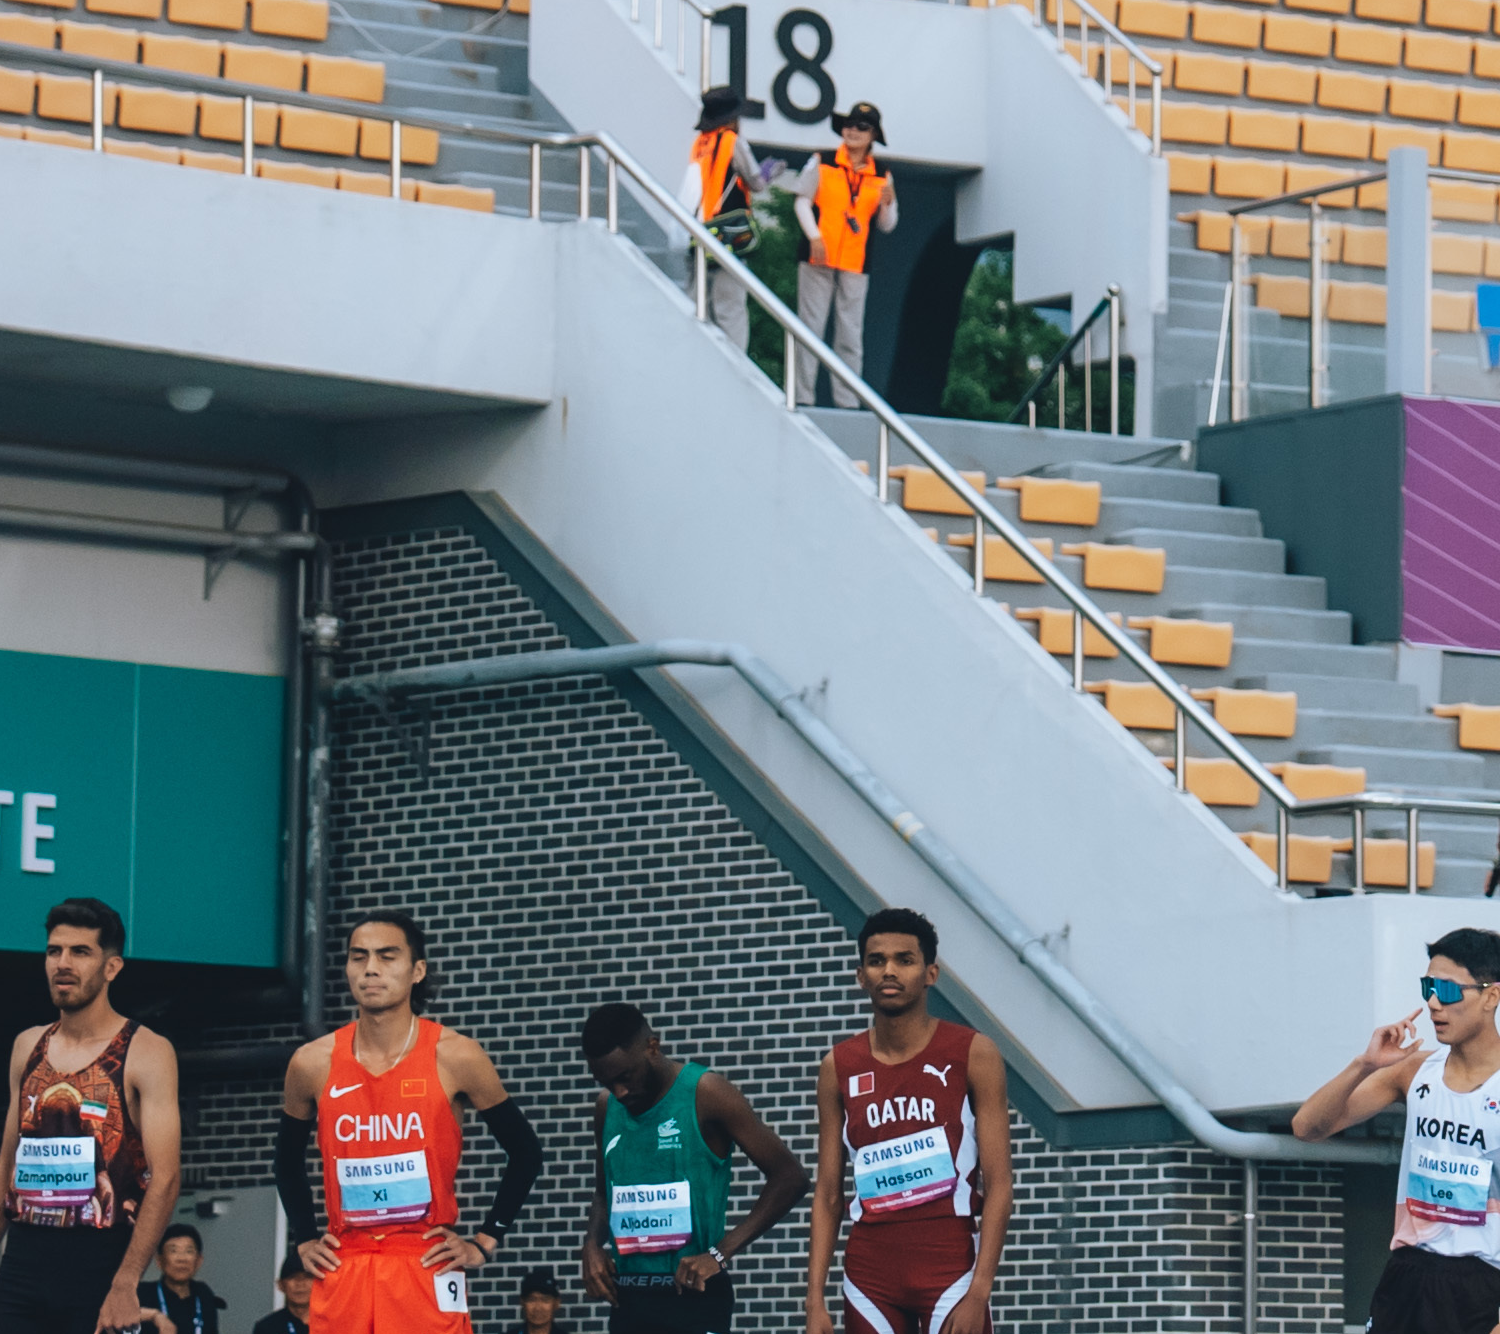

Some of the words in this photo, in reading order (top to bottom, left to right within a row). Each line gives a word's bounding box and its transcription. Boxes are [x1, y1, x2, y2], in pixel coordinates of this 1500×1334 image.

[709, 4, 837, 124] 18
[866, 1096, 935, 1128] QATAR
[335, 1112, 425, 1142] CHINA
[1416, 1116, 1487, 1150] KOREA
[22, 1143, 82, 1157] SAMSUNG
[863, 1136, 935, 1165] SAMSUNG
[345, 1159, 415, 1178] SAMSUNG
[1417, 1154, 1479, 1177] SAMSUNG
[18, 1169, 89, 1186] Zamanpour
[875, 1167, 933, 1189] Hassan
[372, 1187, 388, 1203] Xi
[615, 1188, 678, 1205] SAMSUNG
[1430, 1184, 1454, 1201] Lee
[620, 1213, 673, 1232] Aljadani
[447, 1280, 458, 1301] 9
[650, 1275, 676, 1286] PR
